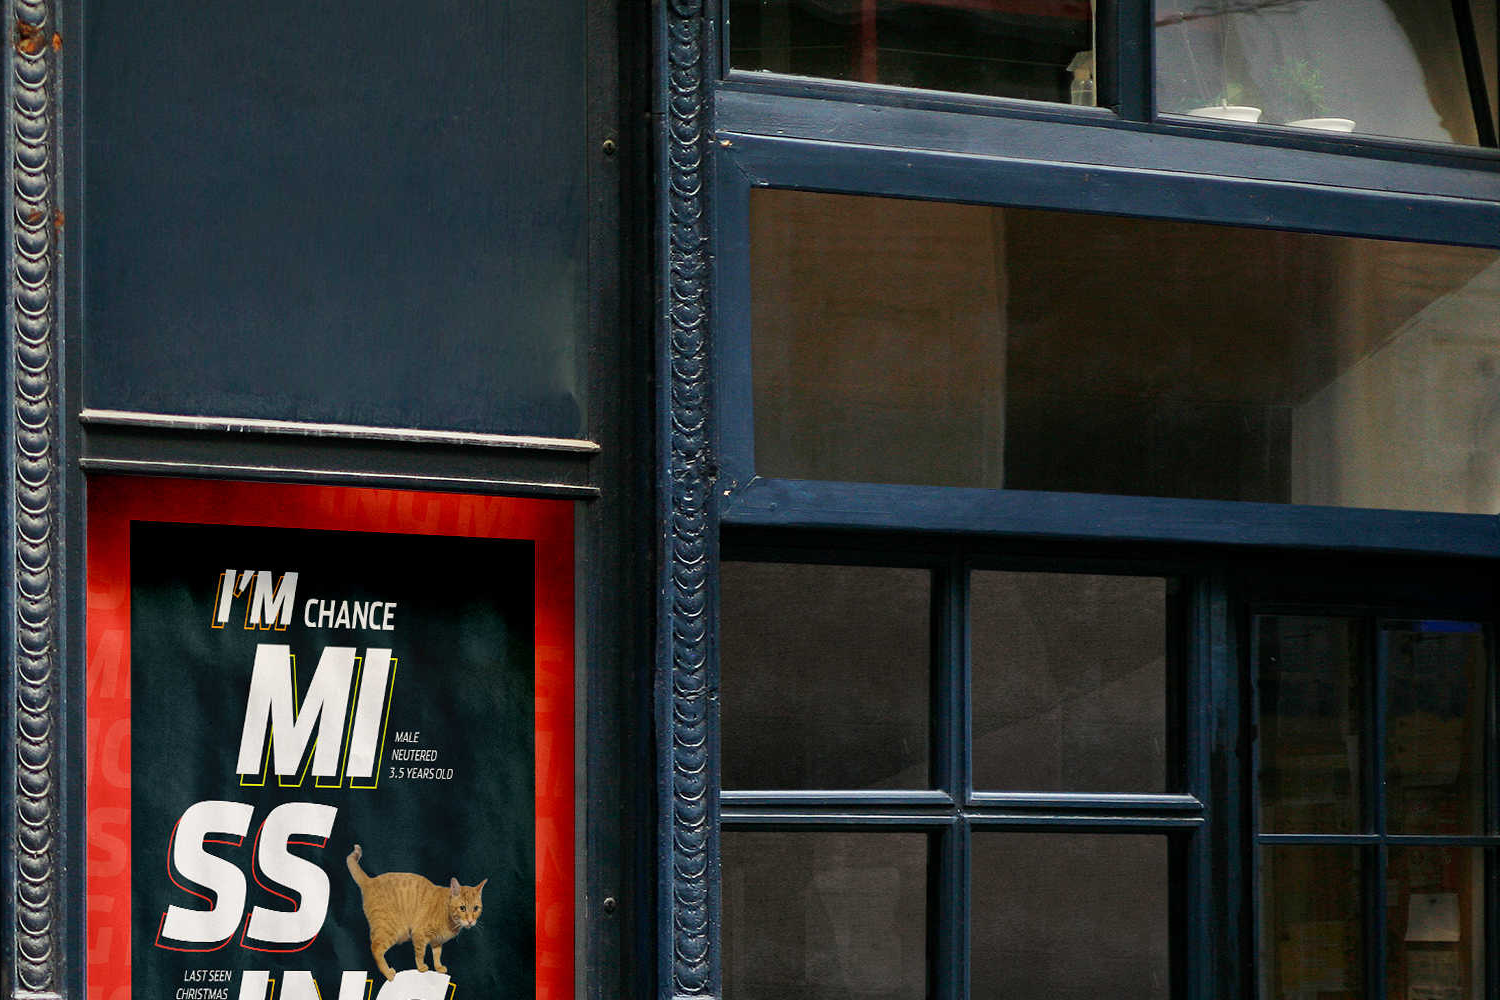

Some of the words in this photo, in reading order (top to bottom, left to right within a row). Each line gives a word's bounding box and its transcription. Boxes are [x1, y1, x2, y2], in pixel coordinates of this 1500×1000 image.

[211, 569, 299, 631] I'M
[304, 598, 397, 632] CHANCE
[236, 643, 398, 789] MI
[394, 731, 420, 743] MALE
[391, 749, 438, 762] NEUTERED
[388, 766, 405, 779] 3.5
[406, 767, 435, 780] YEARS
[435, 768, 454, 780] OLD
[155, 800, 338, 953] SS
[184, 969, 208, 982] LAST
[208, 969, 232, 982] SEEN
[175, 987, 229, 1000] CHRISTMAS
